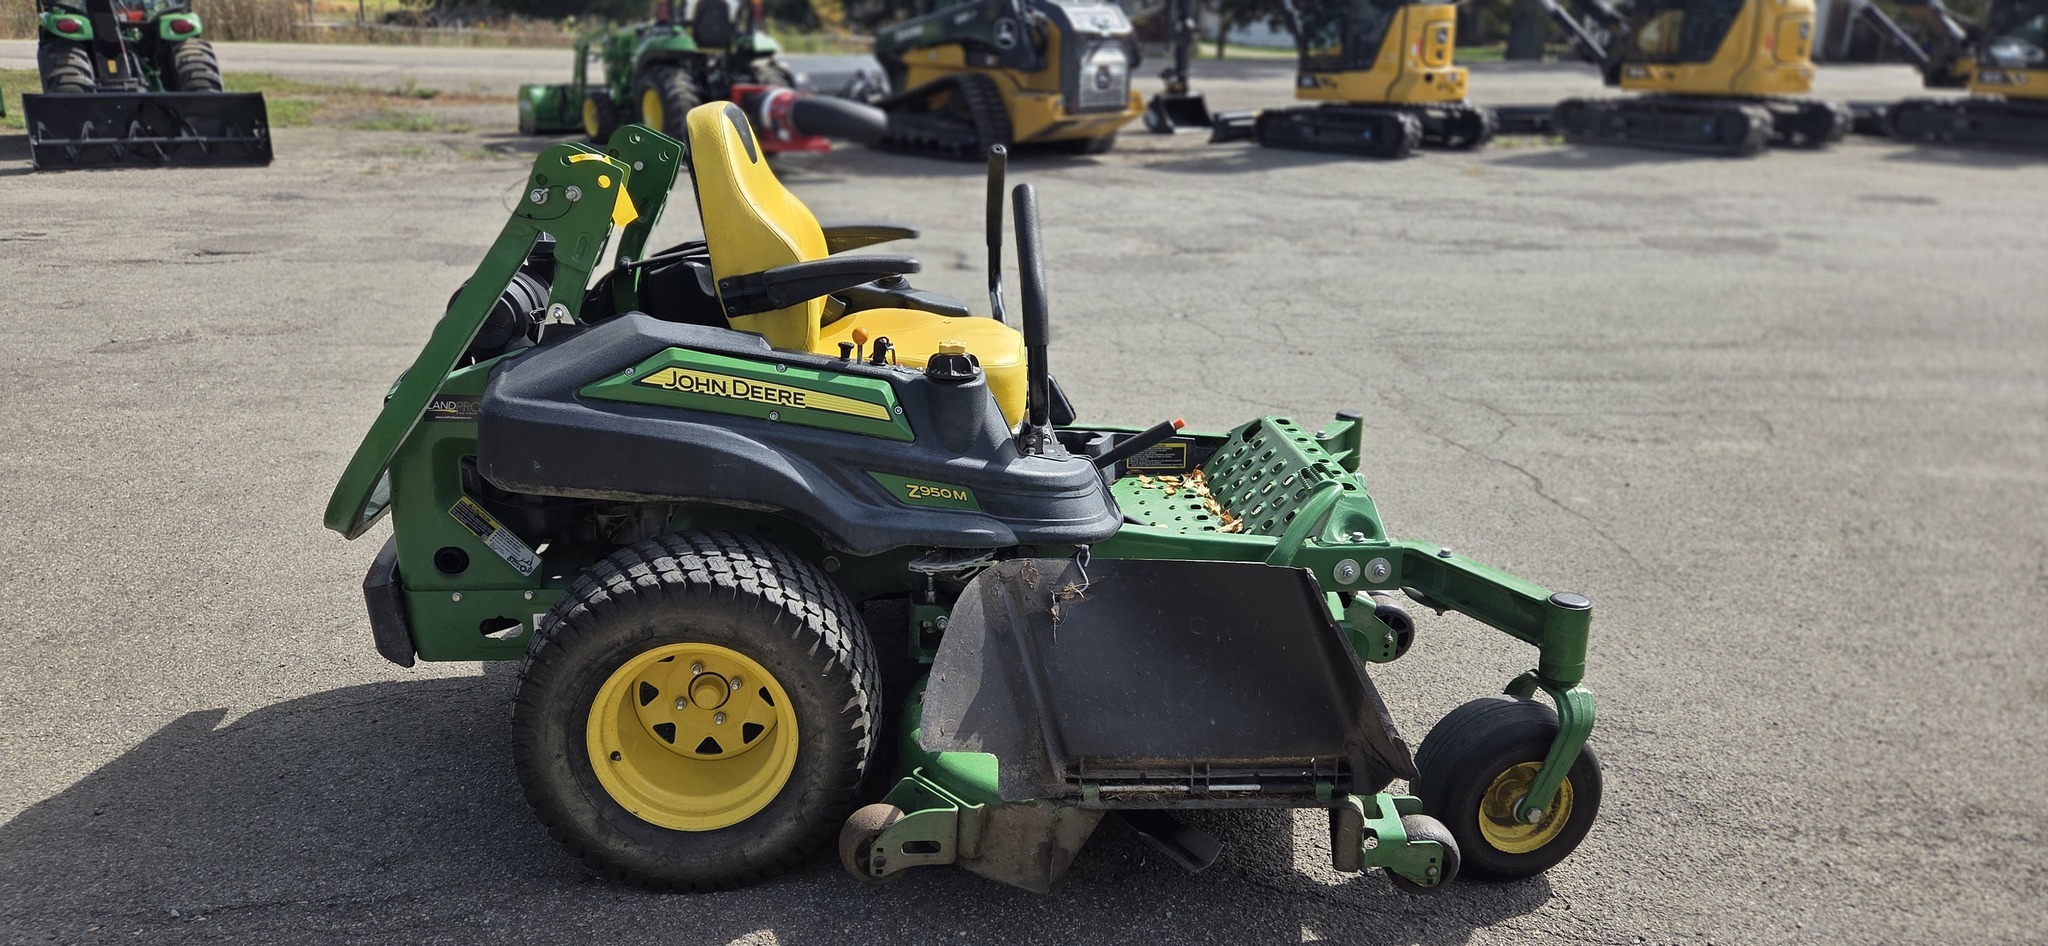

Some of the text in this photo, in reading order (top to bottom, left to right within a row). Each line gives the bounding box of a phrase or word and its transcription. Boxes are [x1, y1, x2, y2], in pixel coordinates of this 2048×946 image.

[664, 370, 806, 407] JOHN DEERE
[472, 504, 492, 523] CAUTION
